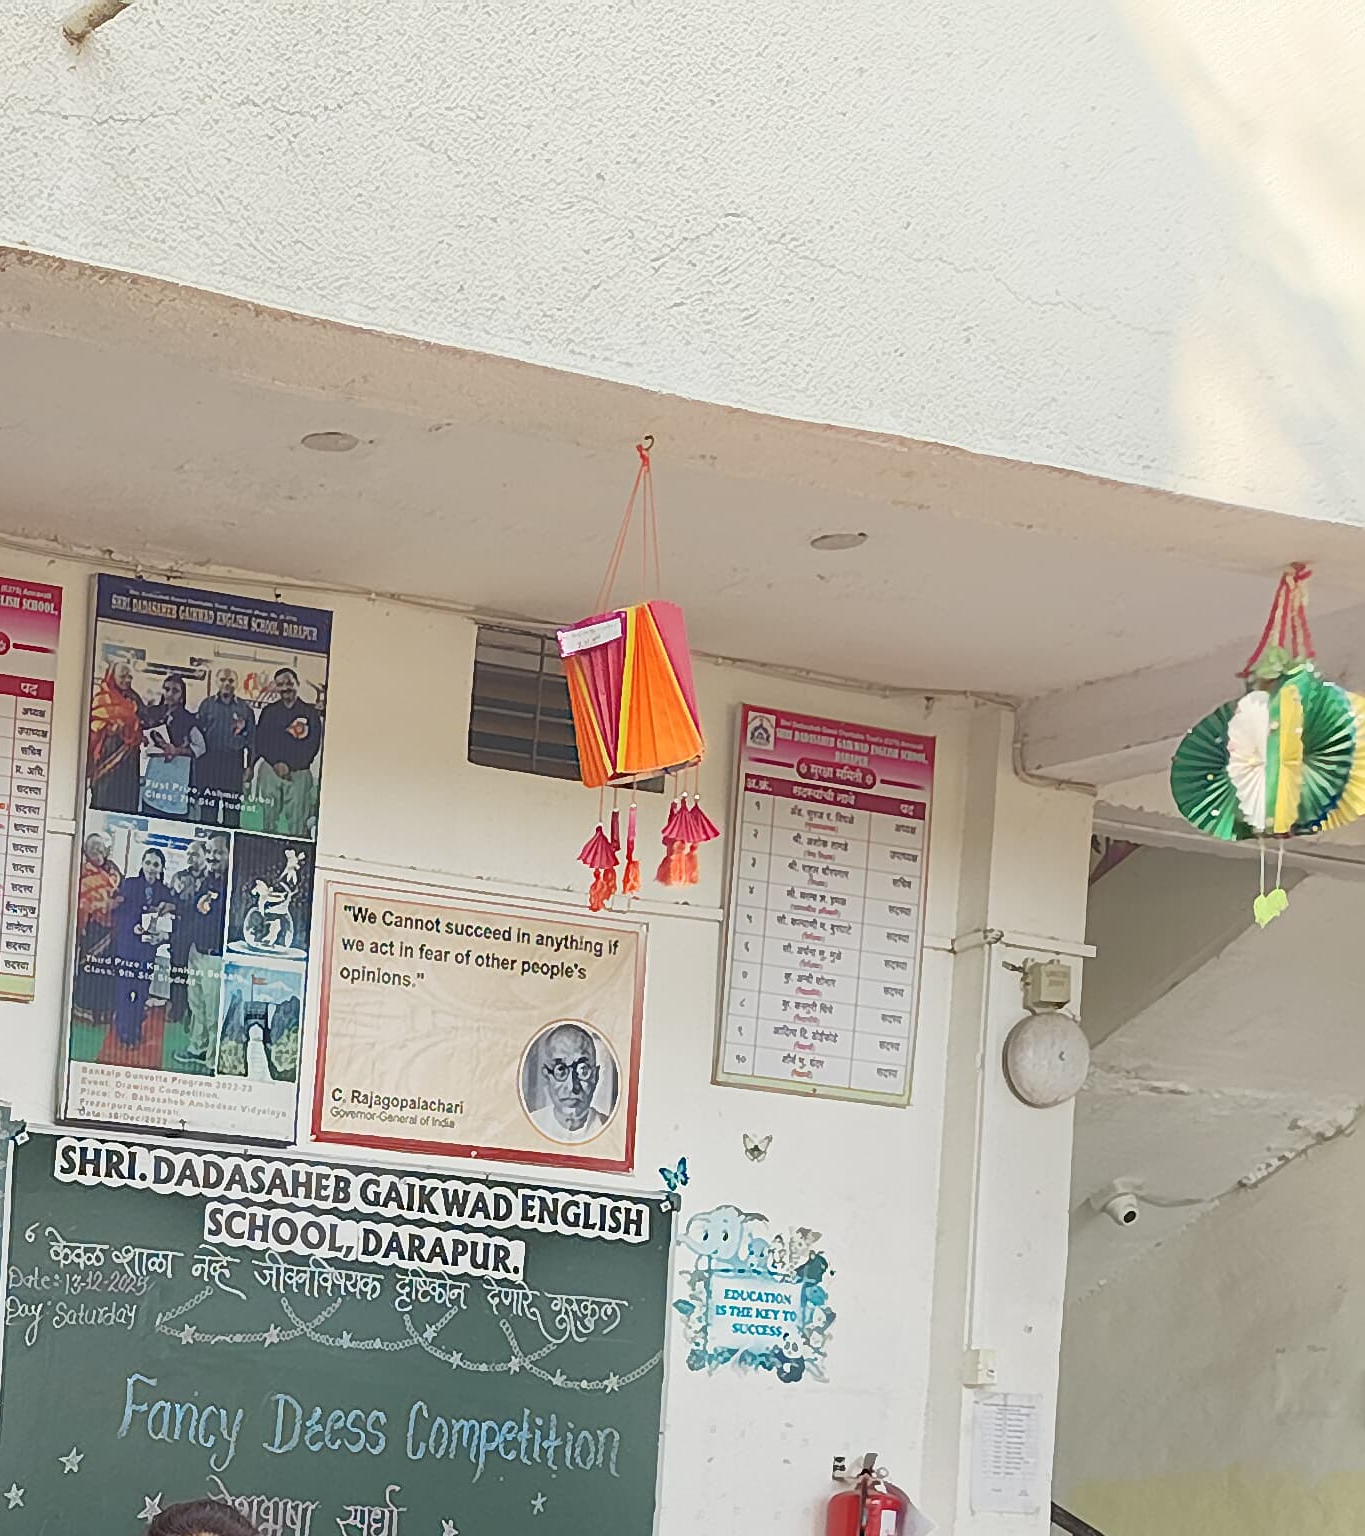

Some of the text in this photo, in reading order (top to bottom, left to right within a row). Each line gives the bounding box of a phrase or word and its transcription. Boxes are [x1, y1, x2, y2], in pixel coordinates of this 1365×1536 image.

[344, 905, 619, 958] "We Cannot succeed in anything if
[342, 938, 586, 980] we act in fear of other people's
[332, 1088, 464, 1114] C. Rajagopalachari
[419, 1115, 431, 1126] of
[431, 1117, 455, 1129] India
[60, 1145, 643, 1237] SHRI. DADASAHEB GAIKWAD ENGLISH
[208, 1209, 520, 1274] SCHOOL, DARAPUR.
[8, 1266, 59, 1290] Date:
[723, 1289, 791, 1305] EDUCATION
[52, 1301, 137, 1330] Saturday
[715, 1305, 797, 1322] IS THE KEY TO
[732, 1323, 782, 1337] SUCCESS
[118, 1373, 243, 1472] Fancy
[407, 1401, 620, 1483] Competition
